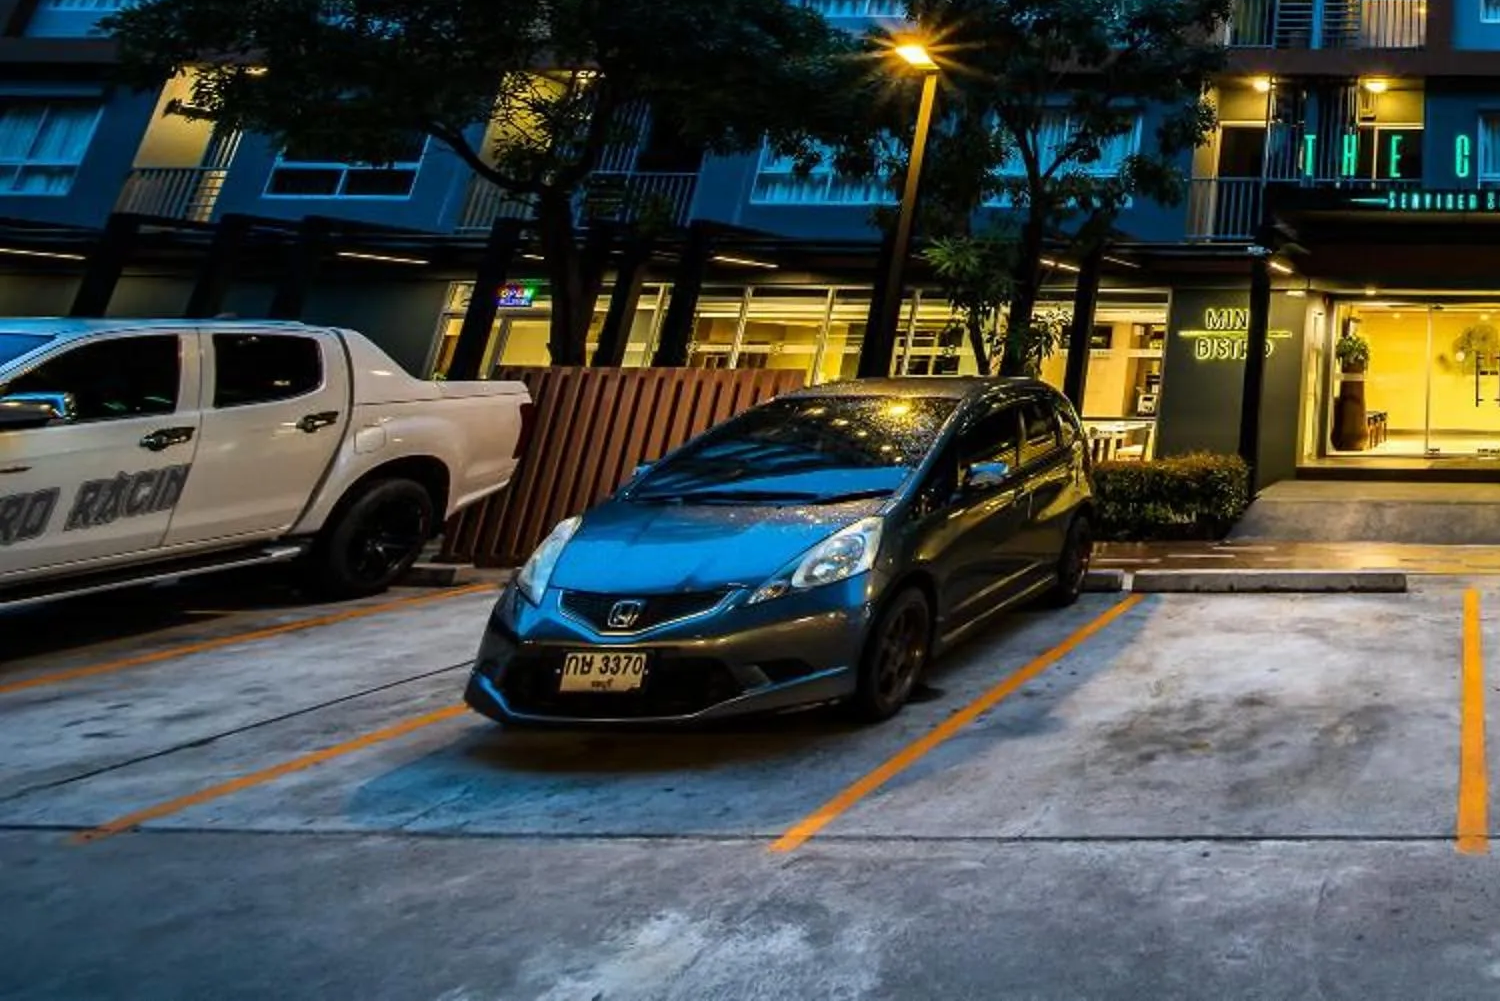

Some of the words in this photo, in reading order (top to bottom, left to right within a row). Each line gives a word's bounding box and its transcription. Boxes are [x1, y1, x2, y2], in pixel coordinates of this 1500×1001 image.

[1304, 134, 1402, 178] THE
[1205, 308, 1250, 330] MIN
[599, 656, 643, 675] 3370
